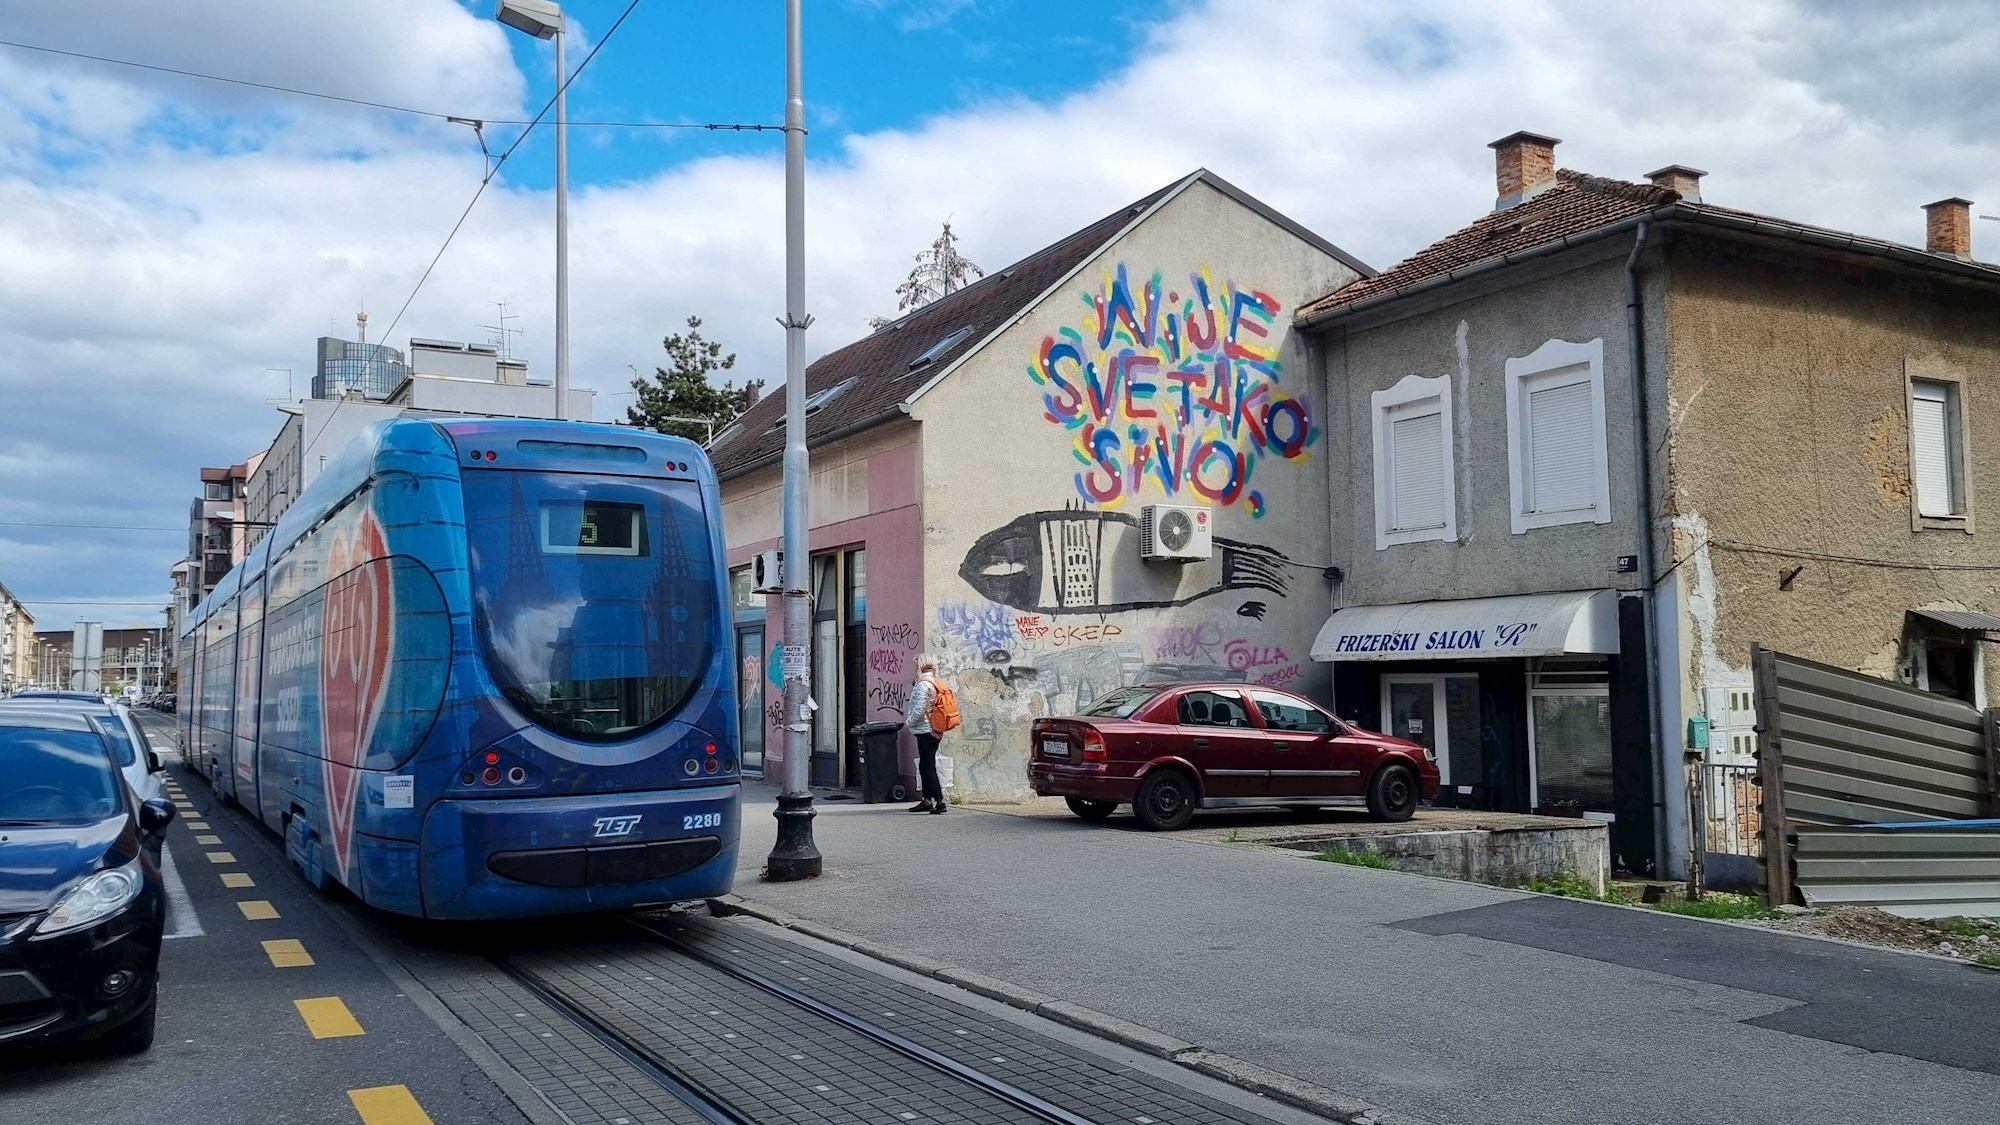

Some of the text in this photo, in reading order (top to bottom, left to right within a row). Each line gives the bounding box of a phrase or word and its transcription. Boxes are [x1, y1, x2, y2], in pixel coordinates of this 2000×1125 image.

[581, 510, 598, 544] 5
[1619, 557, 1629, 566] 47
[1335, 632, 1421, 653] FRIZERSKI
[1424, 629, 1486, 651] SALON
[683, 813, 721, 830] 2280
